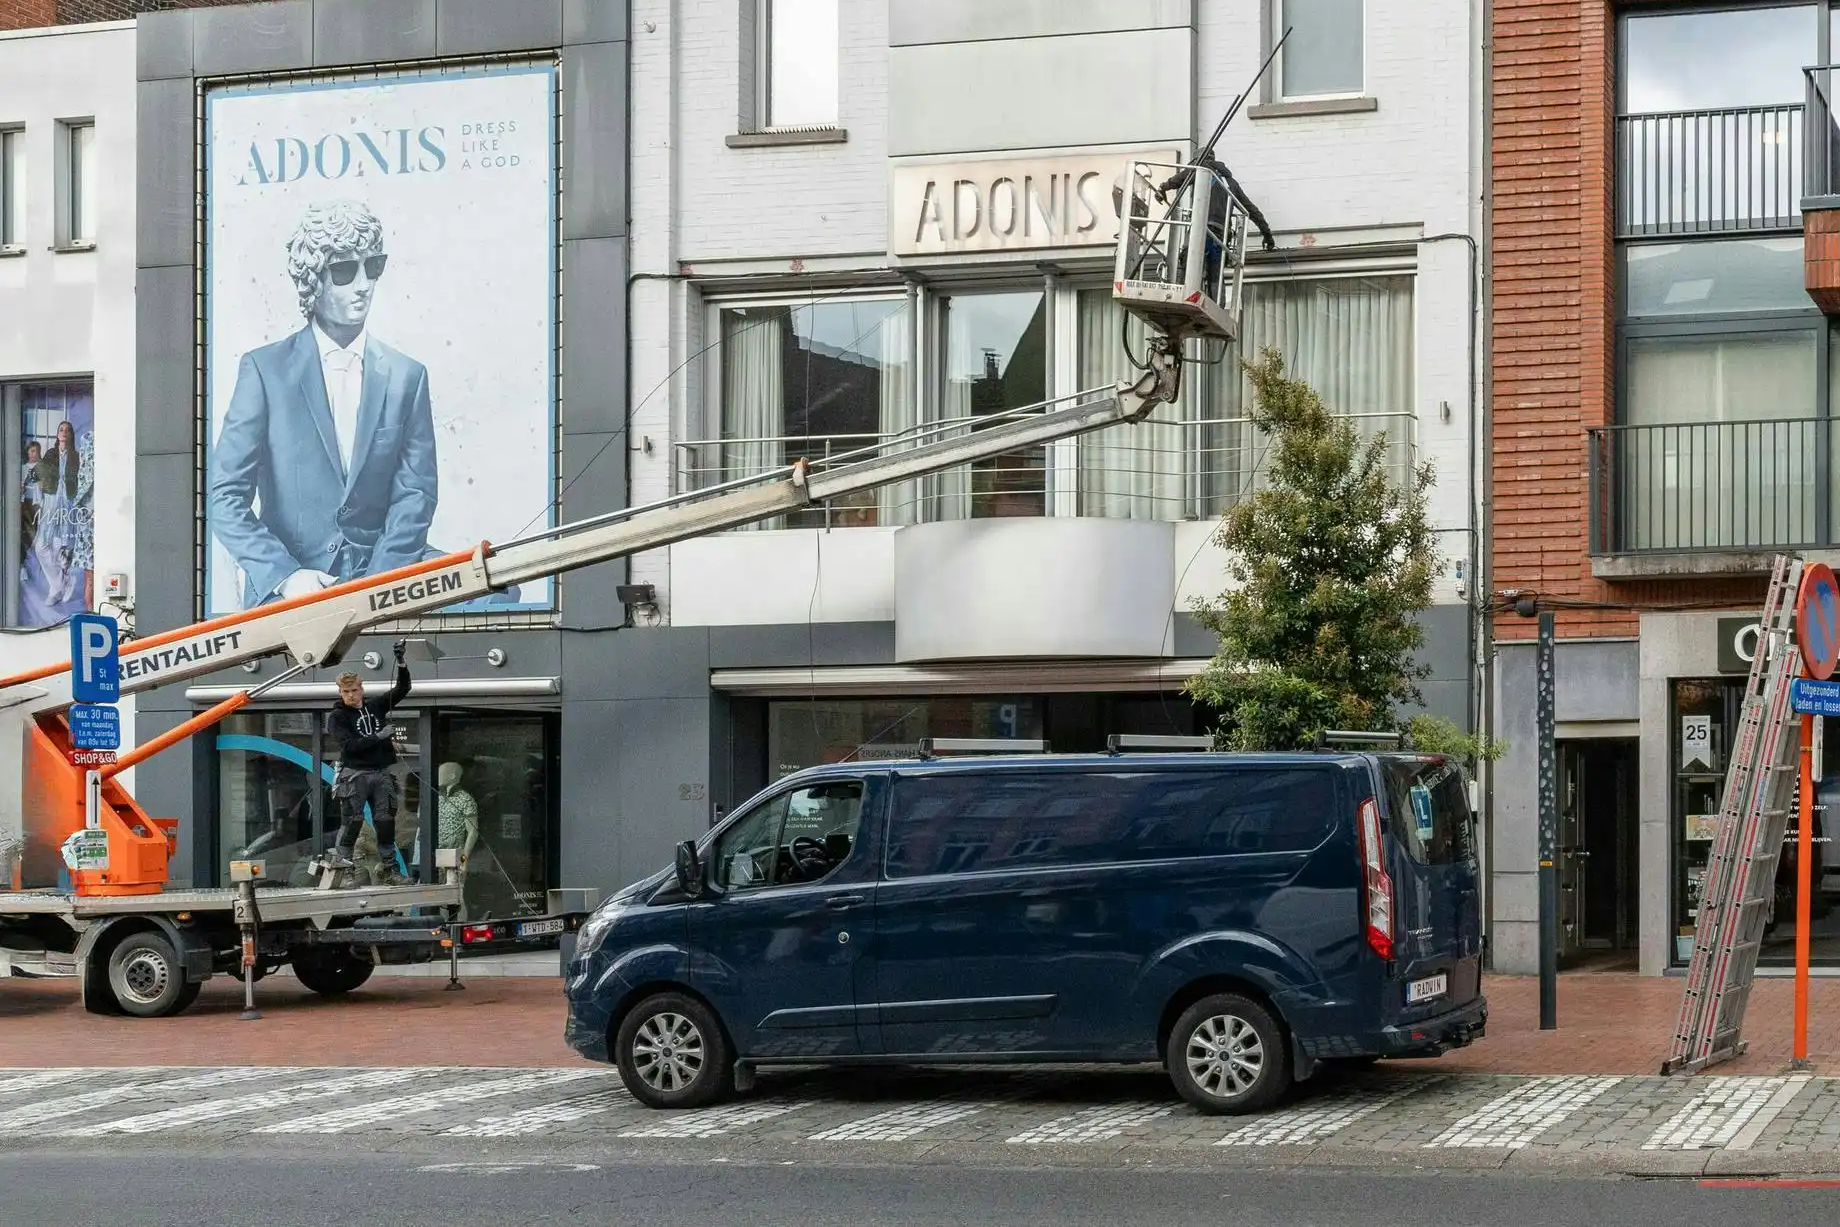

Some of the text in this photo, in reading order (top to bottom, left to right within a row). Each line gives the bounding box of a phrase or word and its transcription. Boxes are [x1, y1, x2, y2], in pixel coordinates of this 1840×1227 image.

[461, 121, 517, 136] DRESS
[461, 139, 500, 153] LIKE
[237, 126, 446, 186] ADONIS
[461, 155, 521, 170] A GOD
[916, 171, 1101, 243] ADONIS
[368, 570, 463, 612] IZEGEM
[82, 622, 112, 682] P
[99, 682, 114, 691] max
[1800, 682, 1840, 698] Uitgezonderd
[1795, 698, 1813, 710] laden
[1814, 701, 1822, 711] en
[91, 709, 101, 720] 30
[1686, 724, 1707, 741] 25
[74, 752, 117, 764] SHOP&GO
[236, 906, 245, 918] 2
